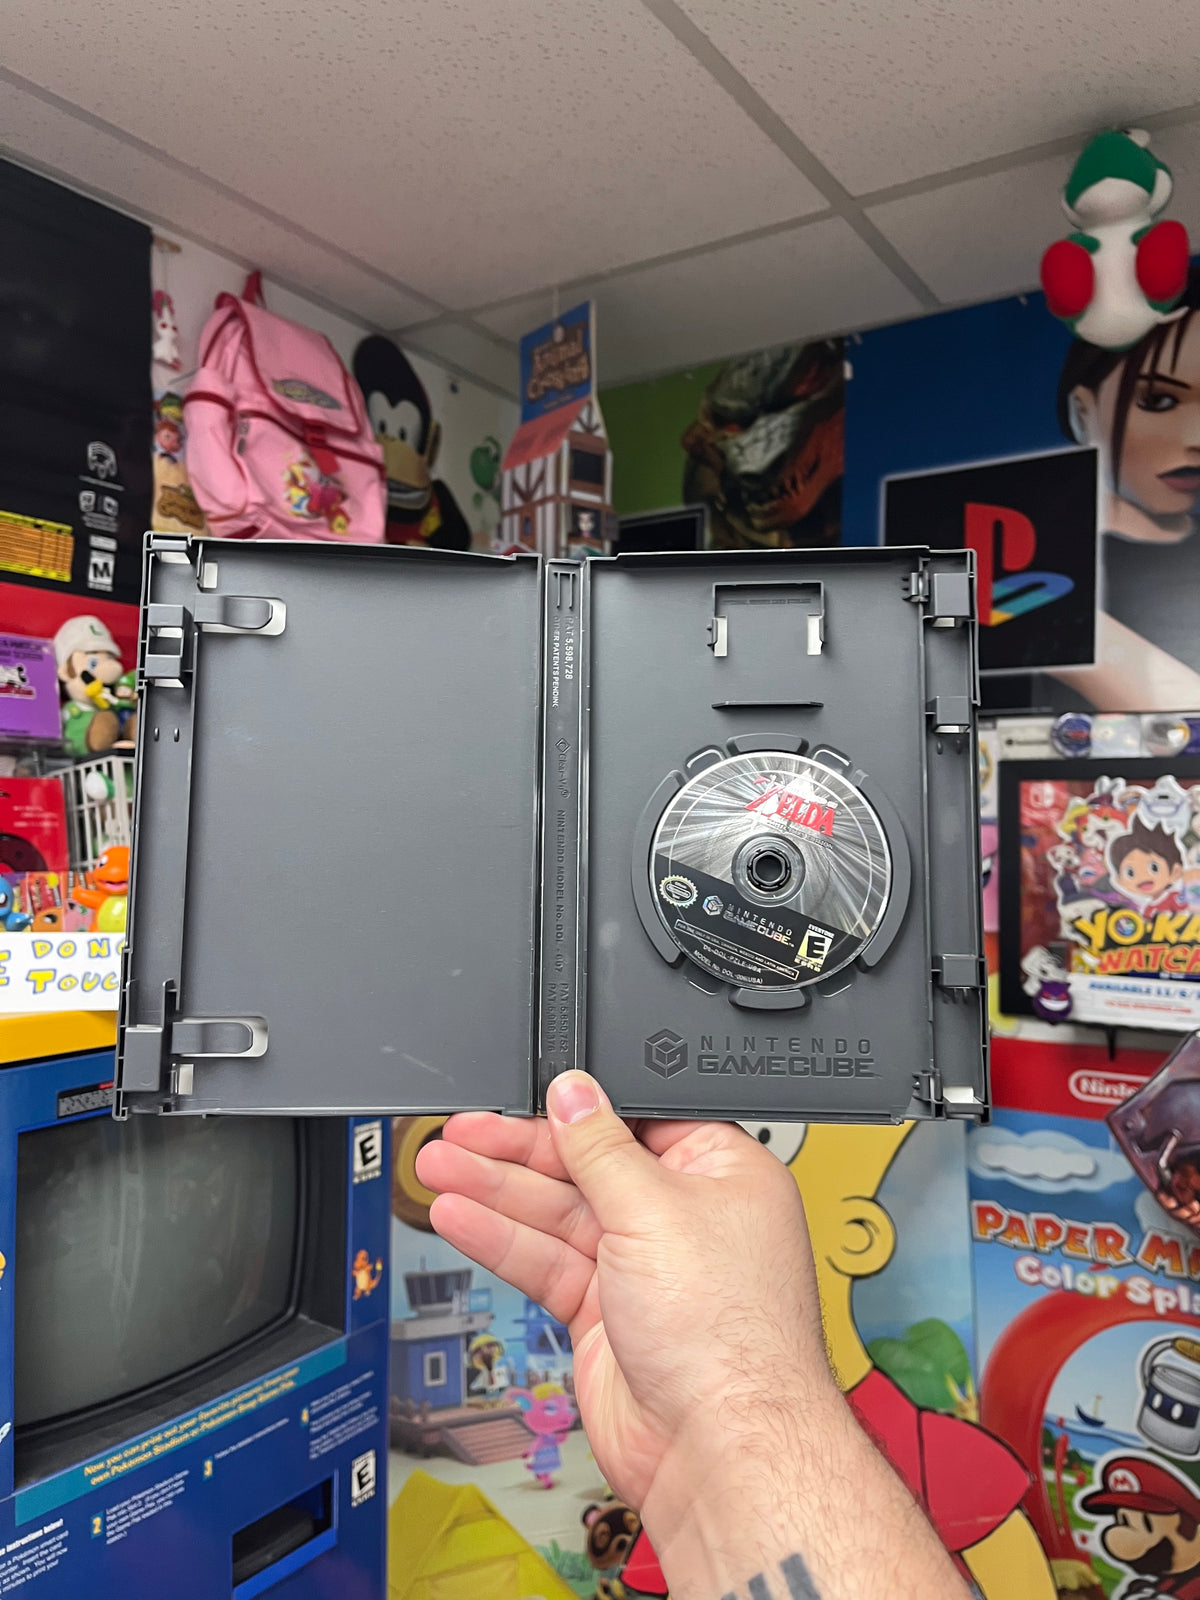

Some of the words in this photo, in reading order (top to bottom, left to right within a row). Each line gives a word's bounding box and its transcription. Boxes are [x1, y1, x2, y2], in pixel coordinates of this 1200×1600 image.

[552, 642, 561, 676] PATENTS
[564, 638, 575, 680] 5,598,728
[744, 775, 835, 838] ZELDA
[556, 809, 567, 862] NINTENDO
[555, 866, 566, 902] MODEL
[722, 912, 790, 946] GAMECUBE
[727, 902, 792, 937] NINTENDO
[807, 923, 836, 939] EVERYONE
[693, 949, 713, 966] MODEL
[806, 935, 826, 959] E
[1088, 980, 1152, 996] AVAILABLE
[701, 1035, 871, 1054] NINTENDO
[697, 1054, 875, 1079] GAMECUBE
[360, 1134, 377, 1166] E
[970, 1200, 1135, 1269] PAPER
[1014, 1256, 1119, 1299] Color
[84, 1460, 104, 1474] Now
[90, 1471, 109, 1484] own
[357, 1463, 371, 1490] E
[1113, 1474, 1134, 1491] M
[93, 1517, 101, 1535] 2
